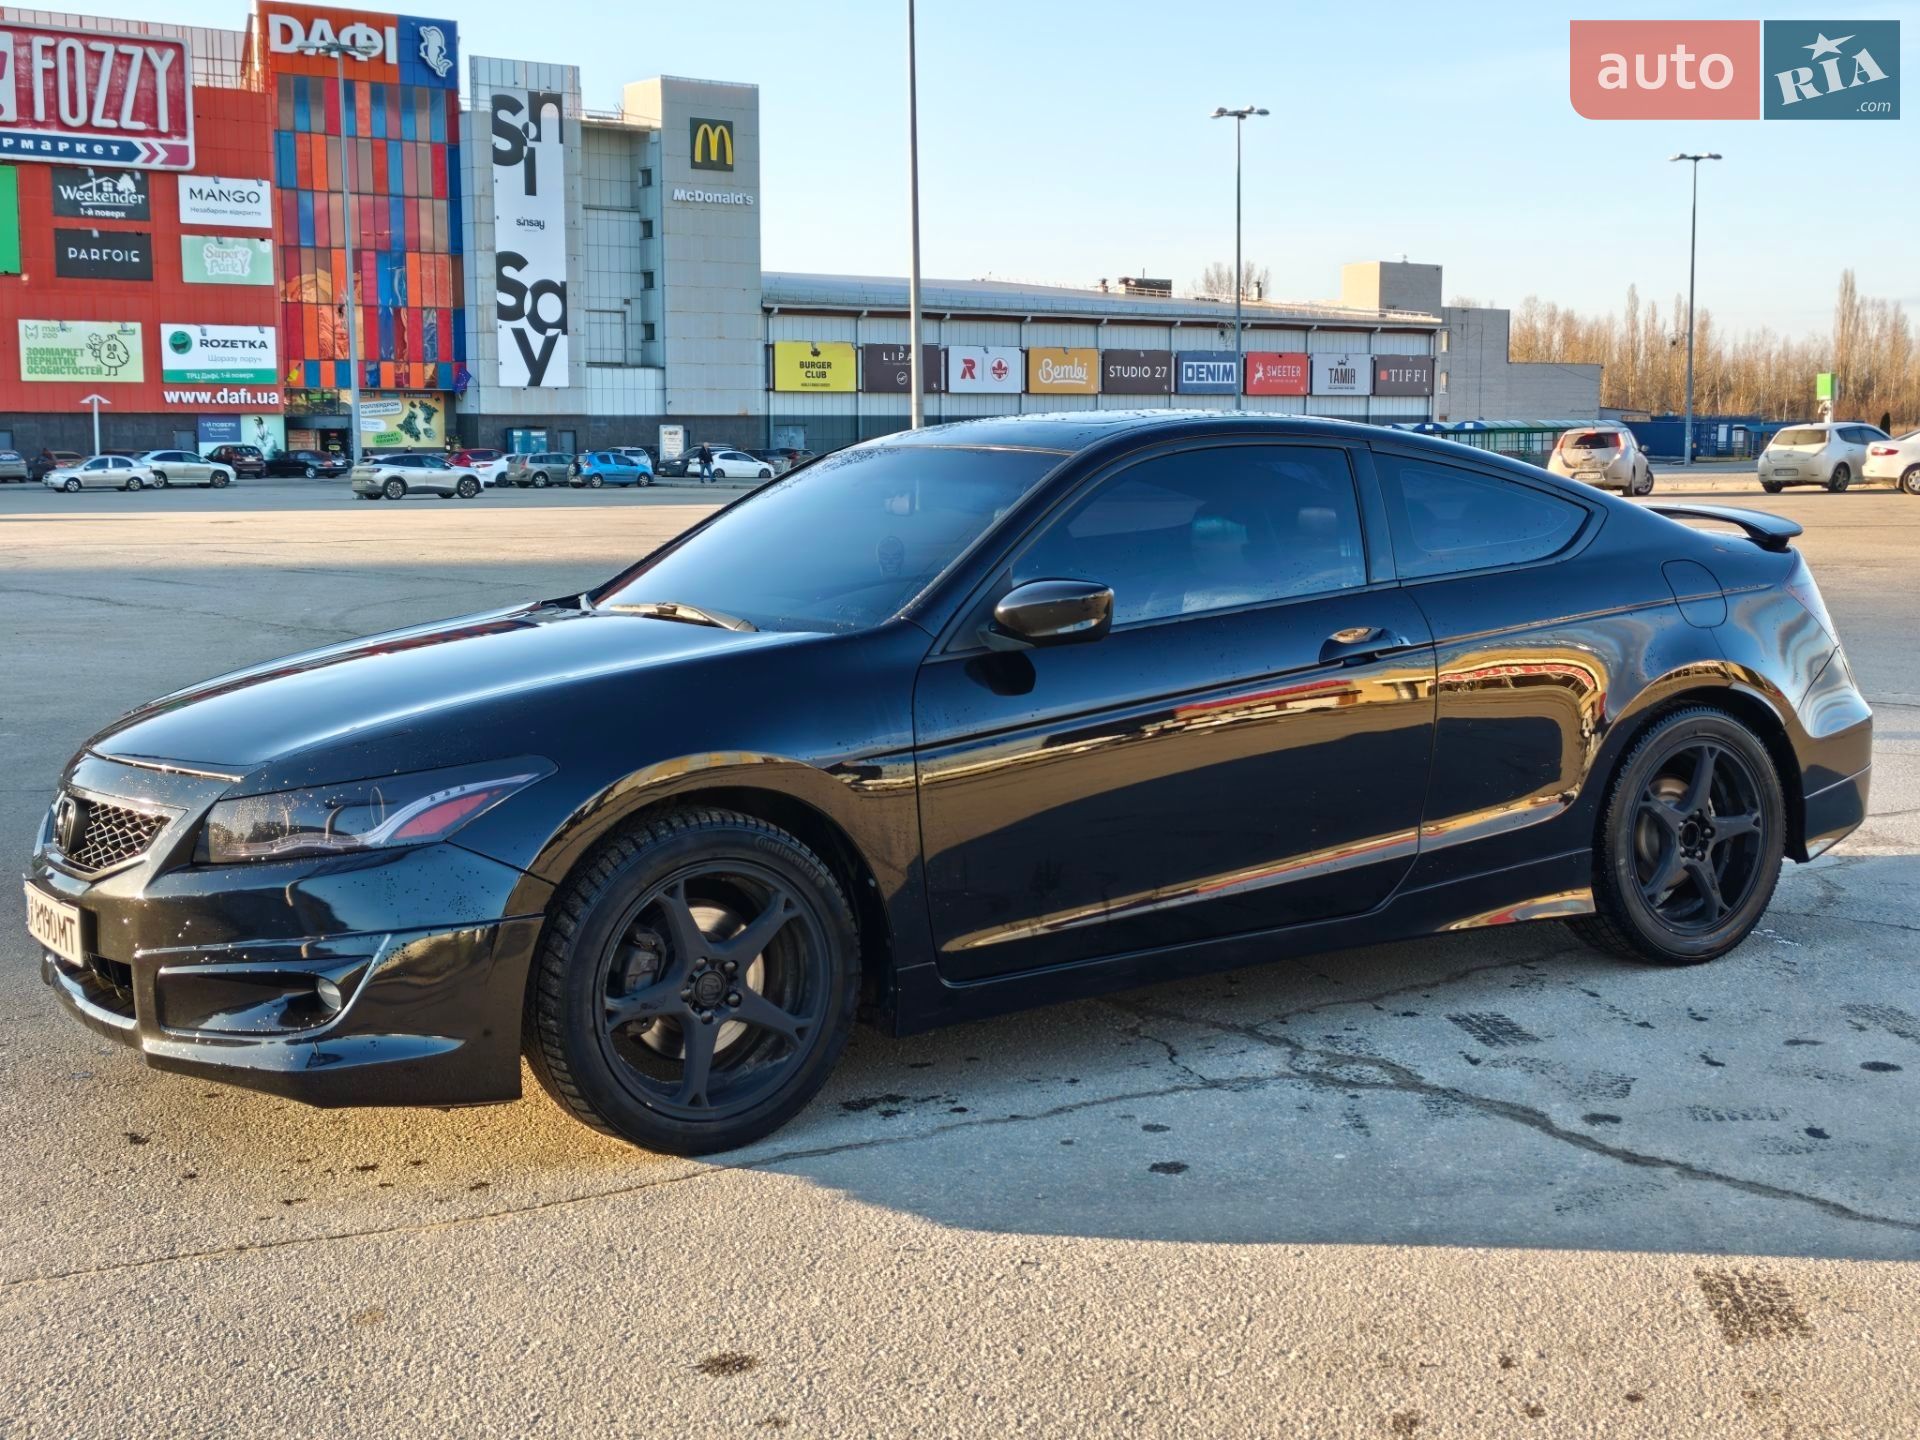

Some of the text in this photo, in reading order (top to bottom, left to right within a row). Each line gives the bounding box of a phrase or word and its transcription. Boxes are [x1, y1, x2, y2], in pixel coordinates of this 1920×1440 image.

[32, 36, 175, 133] FOZZY
[58, 179, 146, 205] Weekender
[189, 187, 261, 204] MANGO
[672, 188, 754, 205] McDonald's
[94, 209, 126, 219] поверх
[516, 216, 545, 230] sinsay
[68, 247, 140, 263] PARFOIS
[205, 245, 240, 261] Super
[199, 339, 268, 349] ROZETKA
[26, 347, 85, 357] ЗООМАРКЕТ
[26, 356, 77, 365] ПЕРНАТИХ
[799, 361, 832, 369] BURGER
[27, 365, 103, 375] ОСОБИСТОСТЕЙ
[805, 370, 827, 379] CLUB
[1039, 358, 1087, 383] Bembi
[1109, 366, 1167, 378] STUDIO 27
[1184, 363, 1235, 382] DENIM
[1266, 365, 1301, 377] SWEETER
[1328, 368, 1356, 384] TAMIR
[1389, 368, 1427, 382] TIFFI
[163, 388, 279, 404] www.dafi.ua
